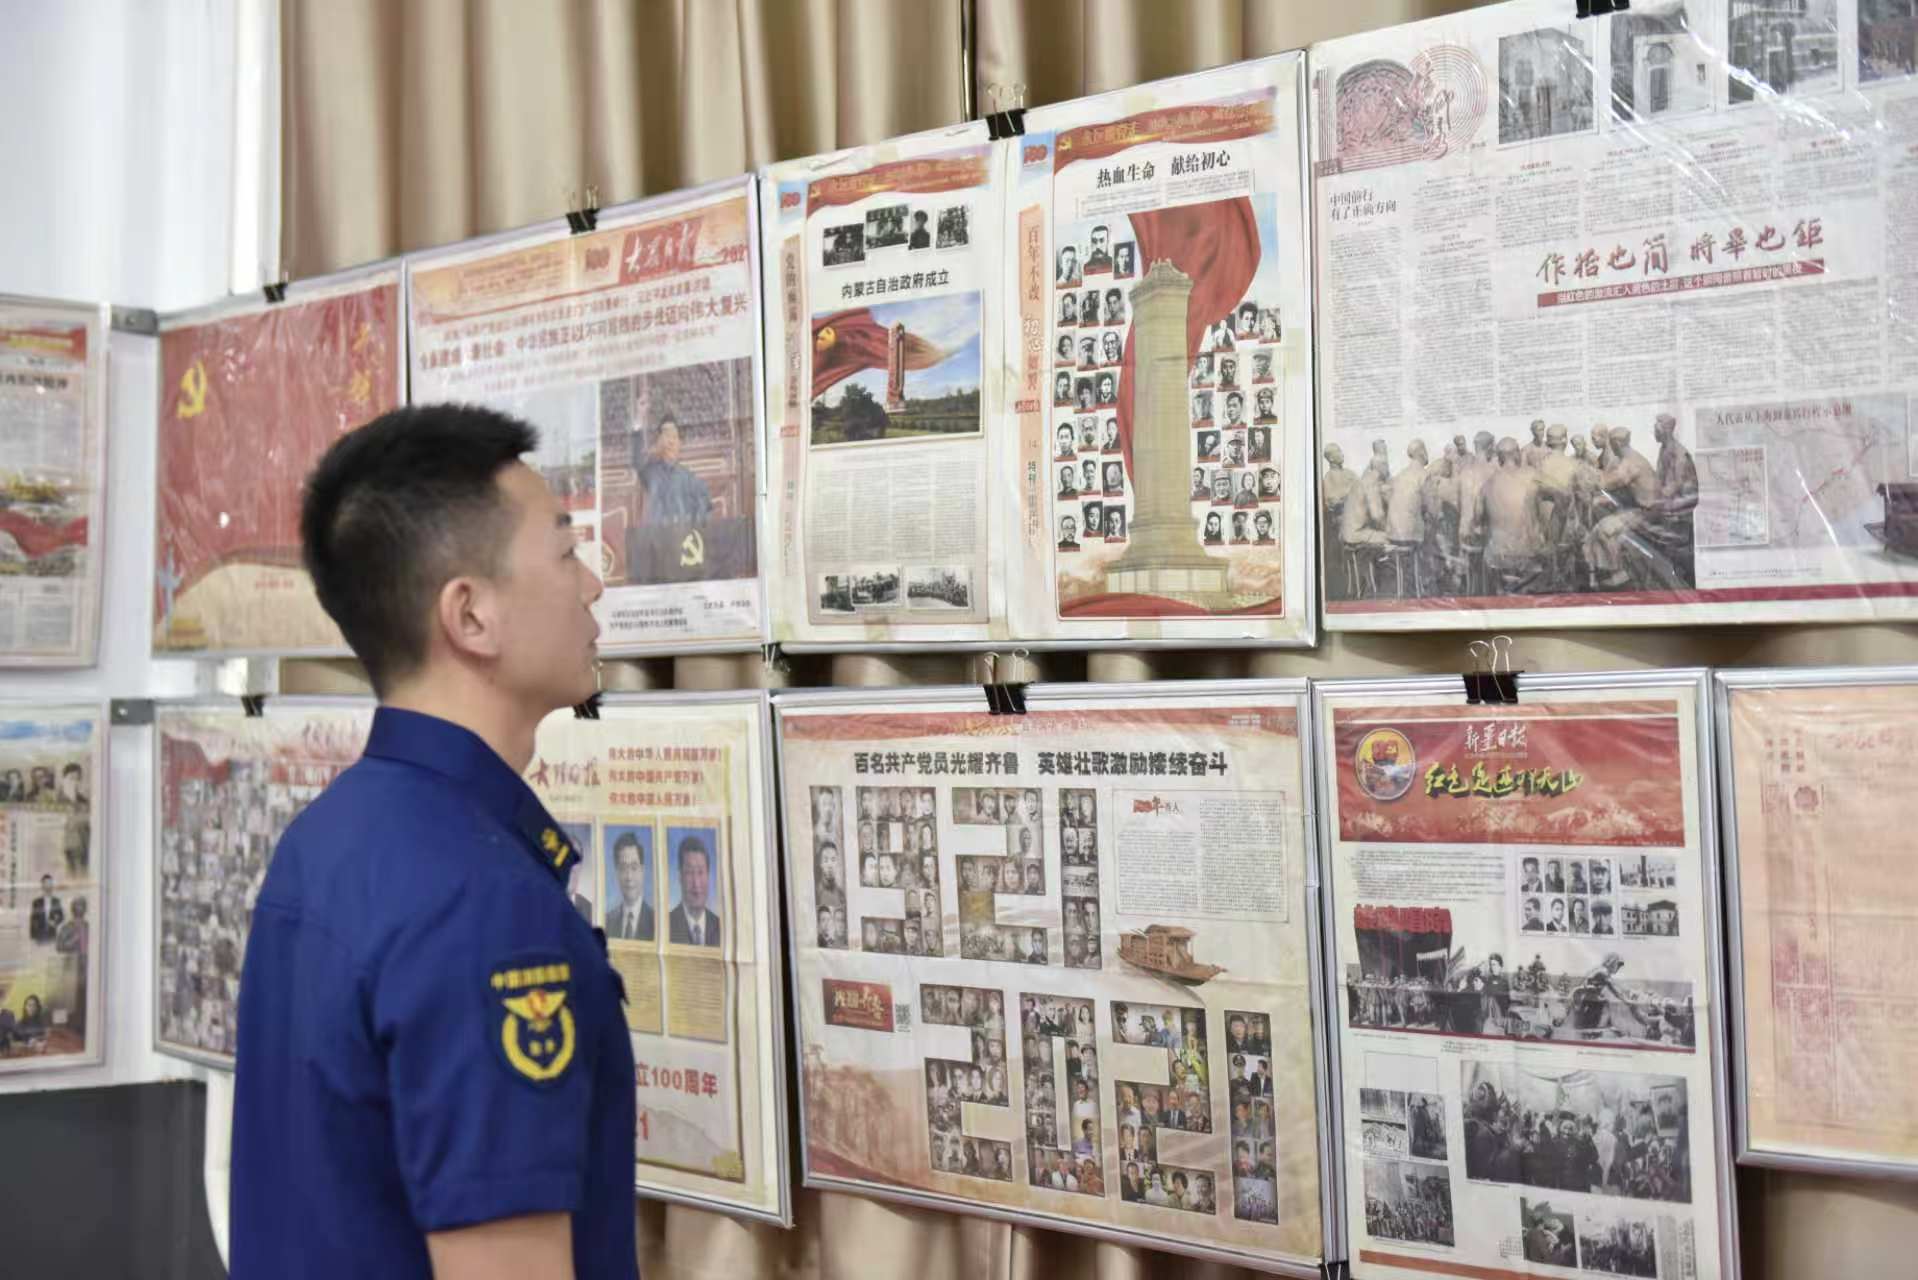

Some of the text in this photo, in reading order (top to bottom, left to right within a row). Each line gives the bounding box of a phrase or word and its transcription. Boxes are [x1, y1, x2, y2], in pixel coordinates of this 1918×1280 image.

[1097, 161, 1155, 188] 热血生命
[1171, 150, 1231, 175] 献给初心
[841, 268, 949, 299] 内蒙古自治政府成立
[854, 751, 1228, 776] 百名共产党员光耀齐鲁 英雄壮歌激励接续奋斗
